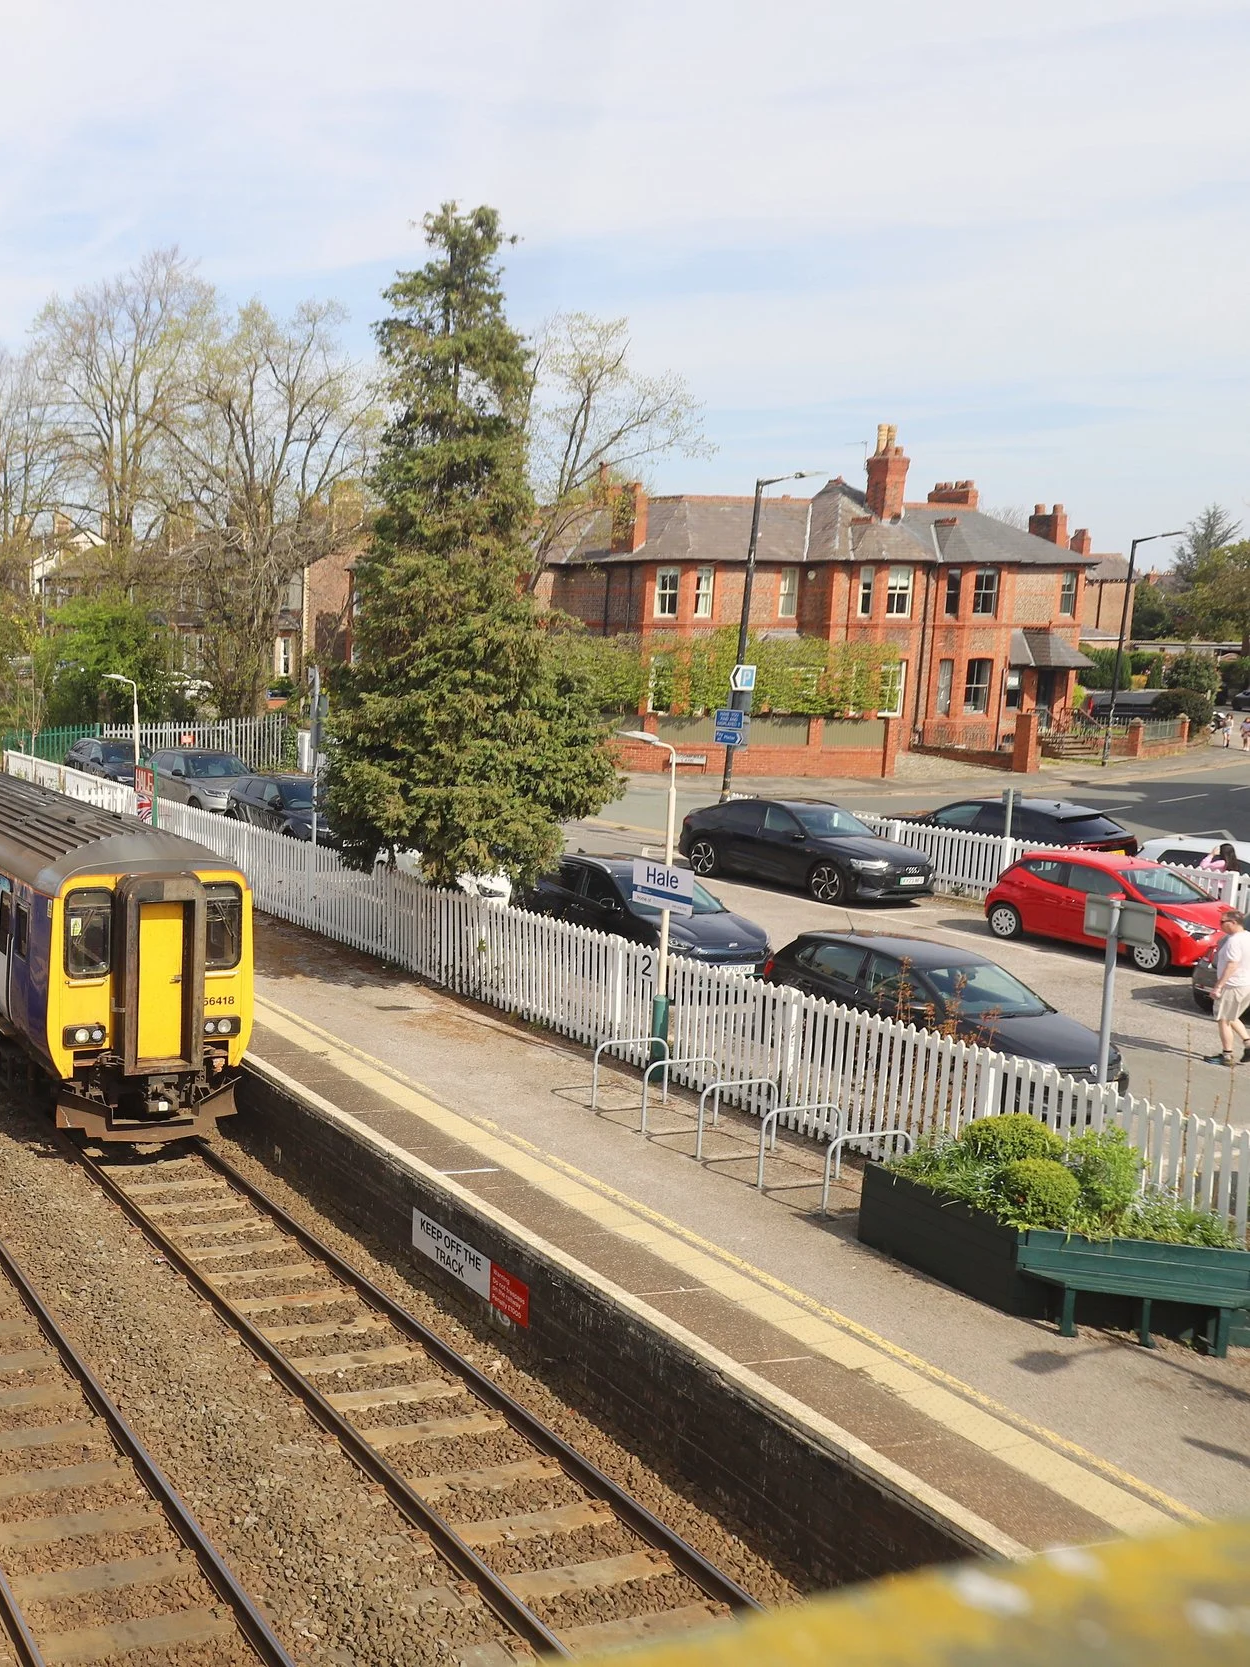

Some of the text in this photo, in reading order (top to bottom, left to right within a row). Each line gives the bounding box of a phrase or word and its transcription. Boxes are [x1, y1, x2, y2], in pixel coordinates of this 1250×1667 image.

[742, 670, 752, 685] P
[646, 866, 679, 889] Hale
[642, 954, 652, 977] 2
[420, 1218, 482, 1272] KEEP OFF THE
[435, 1246, 464, 1278] TRACK
[493, 1270, 510, 1286] Warning
[493, 1277, 499, 1285] Do
[506, 1286, 525, 1305] trespass
[498, 1289, 506, 1298] the
[505, 1294, 521, 1310] railway
[492, 1293, 522, 1319] Penalty £1000
